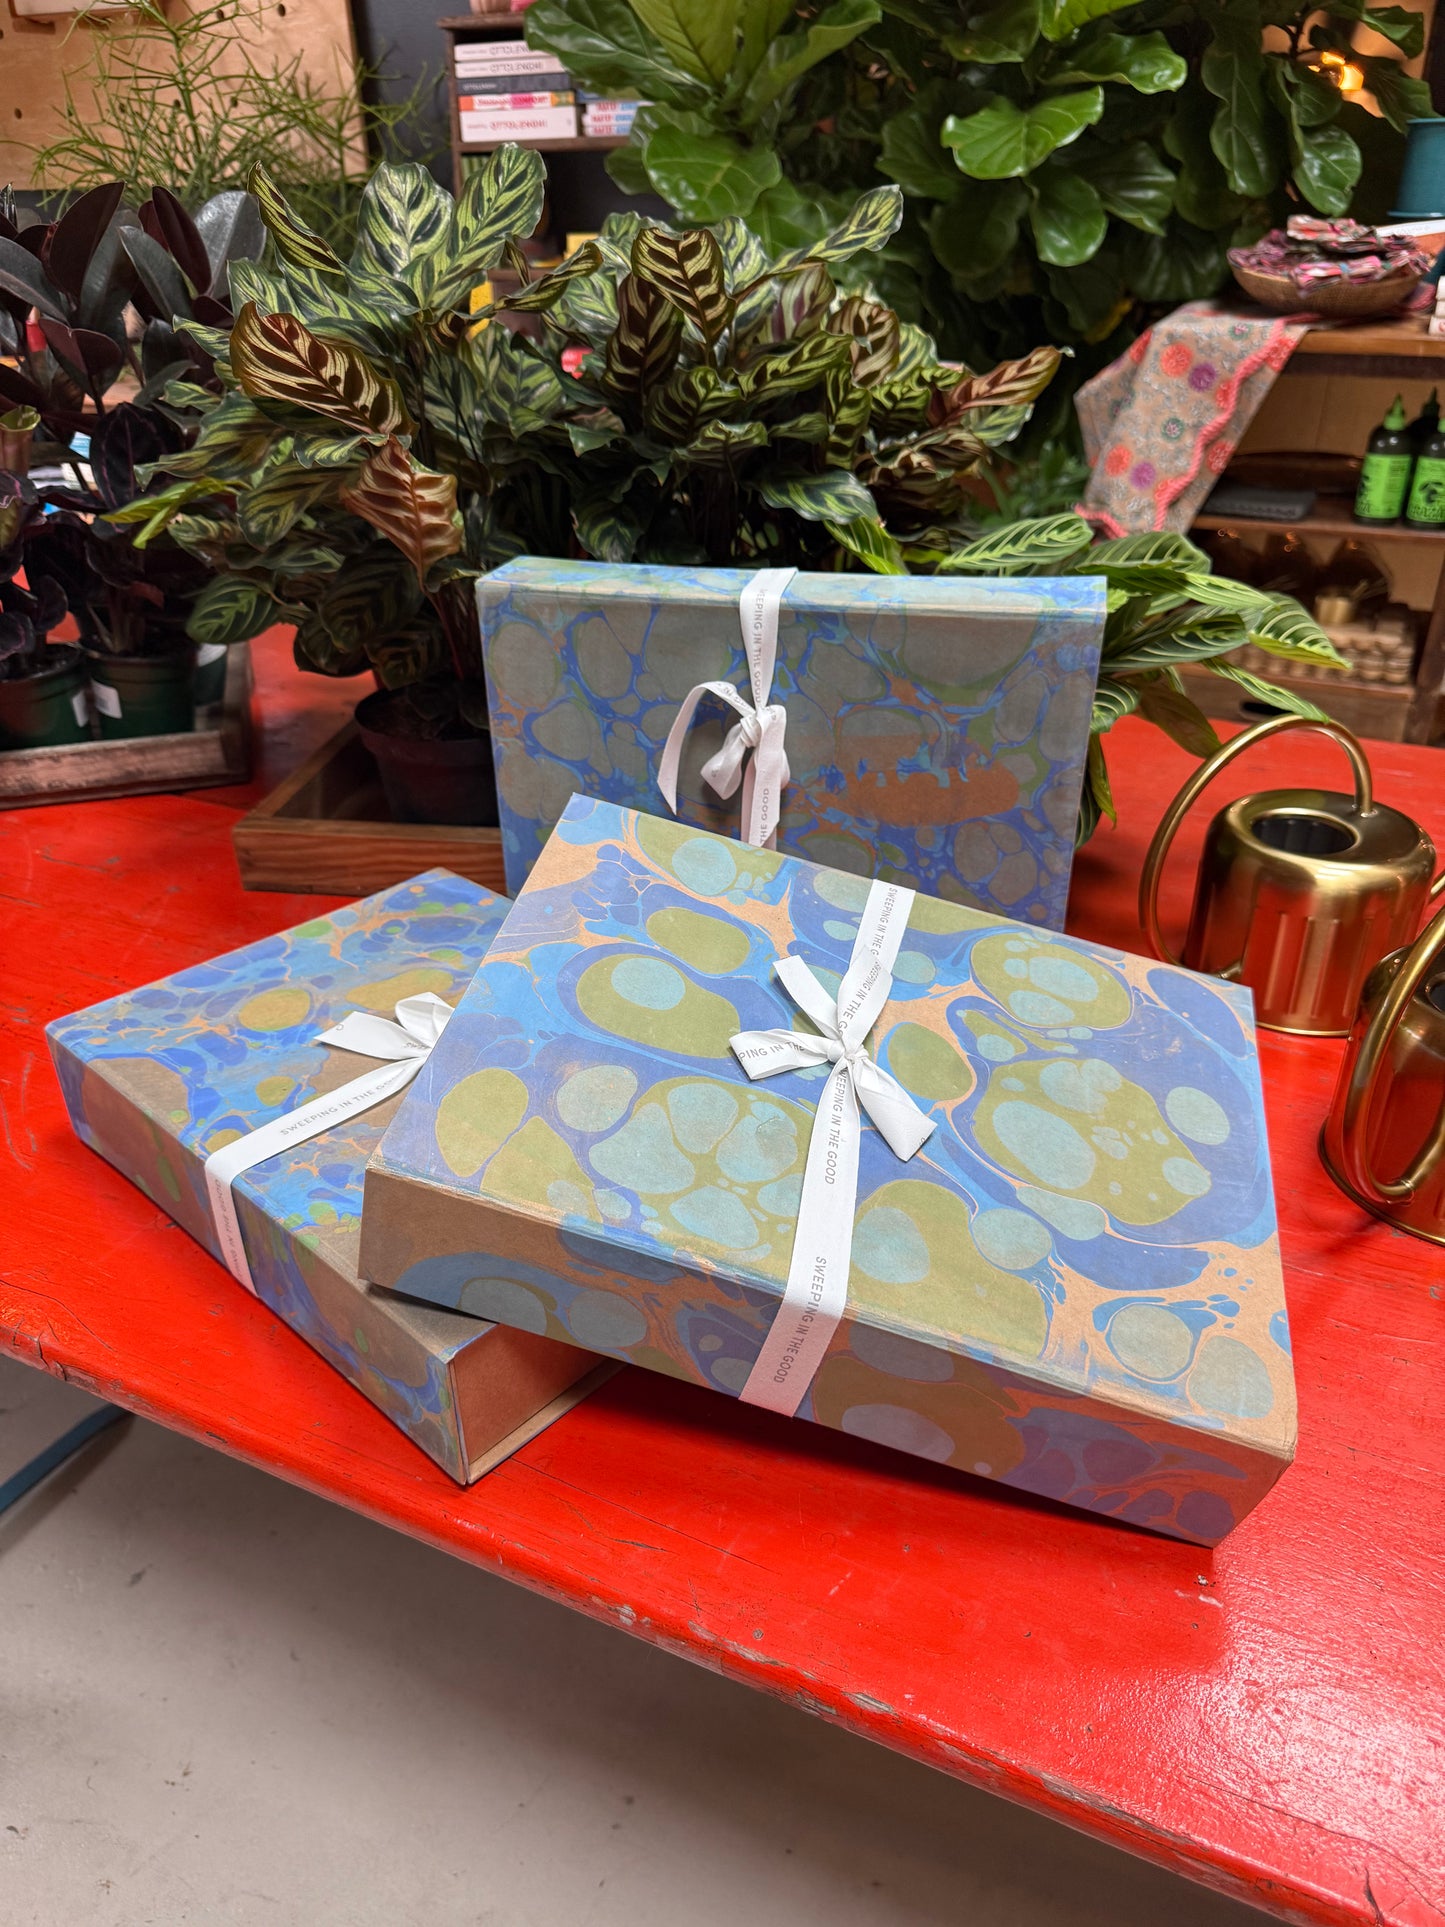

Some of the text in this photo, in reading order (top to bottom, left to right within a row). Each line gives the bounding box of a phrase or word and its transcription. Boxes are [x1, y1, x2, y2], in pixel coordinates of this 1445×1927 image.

[752, 633, 762, 644] IN
[753, 670, 762, 703] GOOD
[761, 788, 769, 821] GOOD
[880, 887, 898, 924] SWEEPING
[872, 934, 885, 949] THE
[876, 924, 887, 934] IN
[856, 988, 867, 1000] IN
[843, 1000, 861, 1020] THE
[738, 1048, 768, 1062] PING
[769, 1044, 784, 1053] IN
[280, 1107, 338, 1136] SWEEPING
[339, 1099, 352, 1109] IN
[353, 1089, 375, 1103] THE
[824, 1067, 848, 1185] WEEPING IN THE GOOD
[773, 1256, 827, 1383] SWEEPING IN THE GOOD
